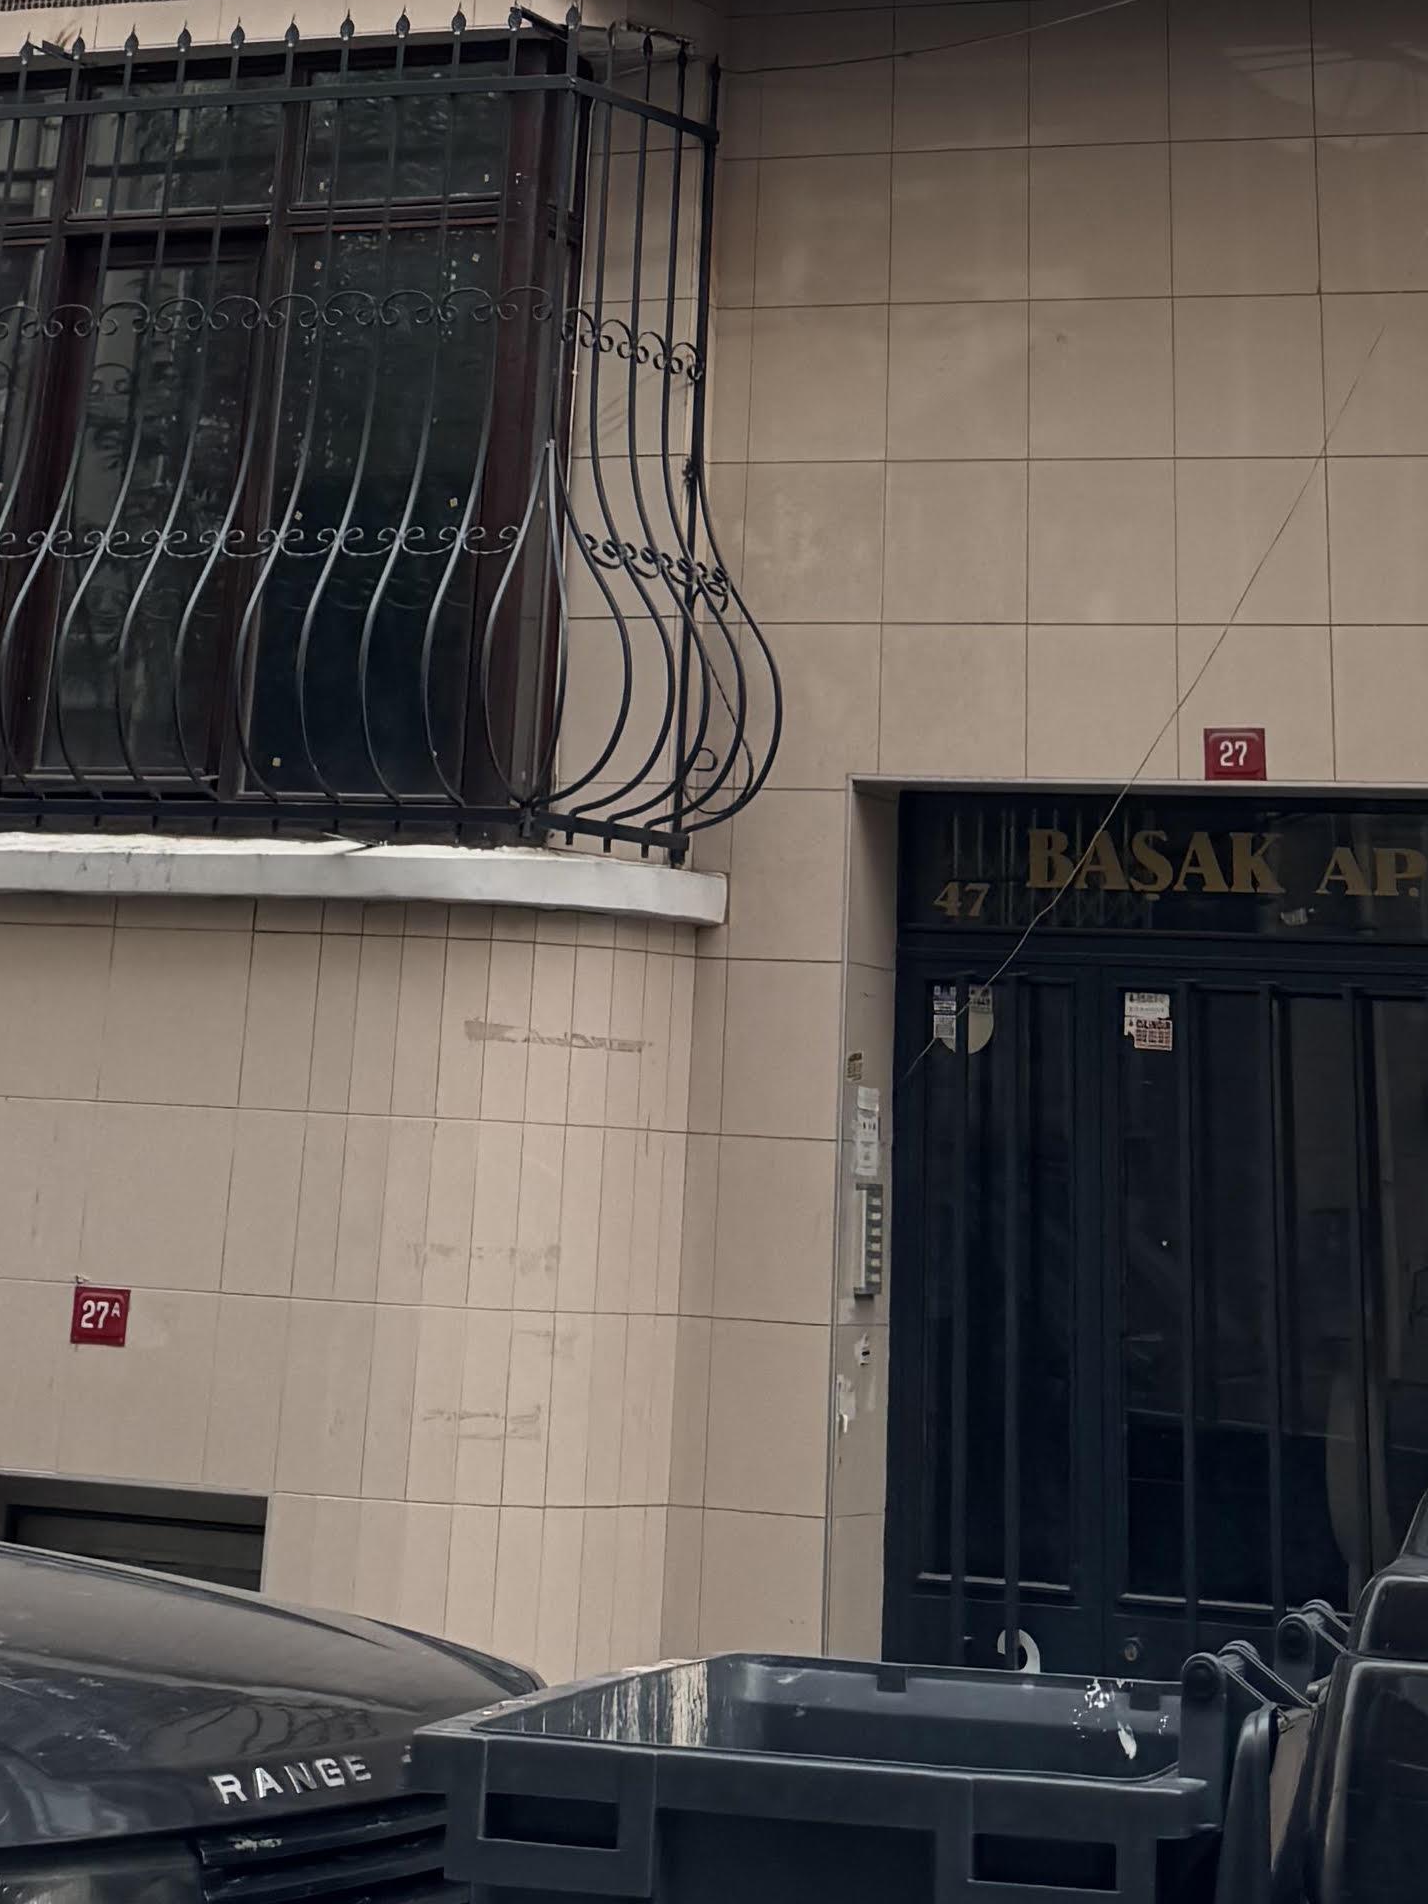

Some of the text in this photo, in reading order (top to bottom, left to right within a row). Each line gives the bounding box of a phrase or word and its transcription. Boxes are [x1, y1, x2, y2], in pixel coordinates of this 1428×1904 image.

[1220, 741, 1248, 767] 27
[1026, 829, 1428, 901] BAŞAK AP.
[933, 882, 990, 917] 47
[209, 1755, 372, 1804] RANGE
